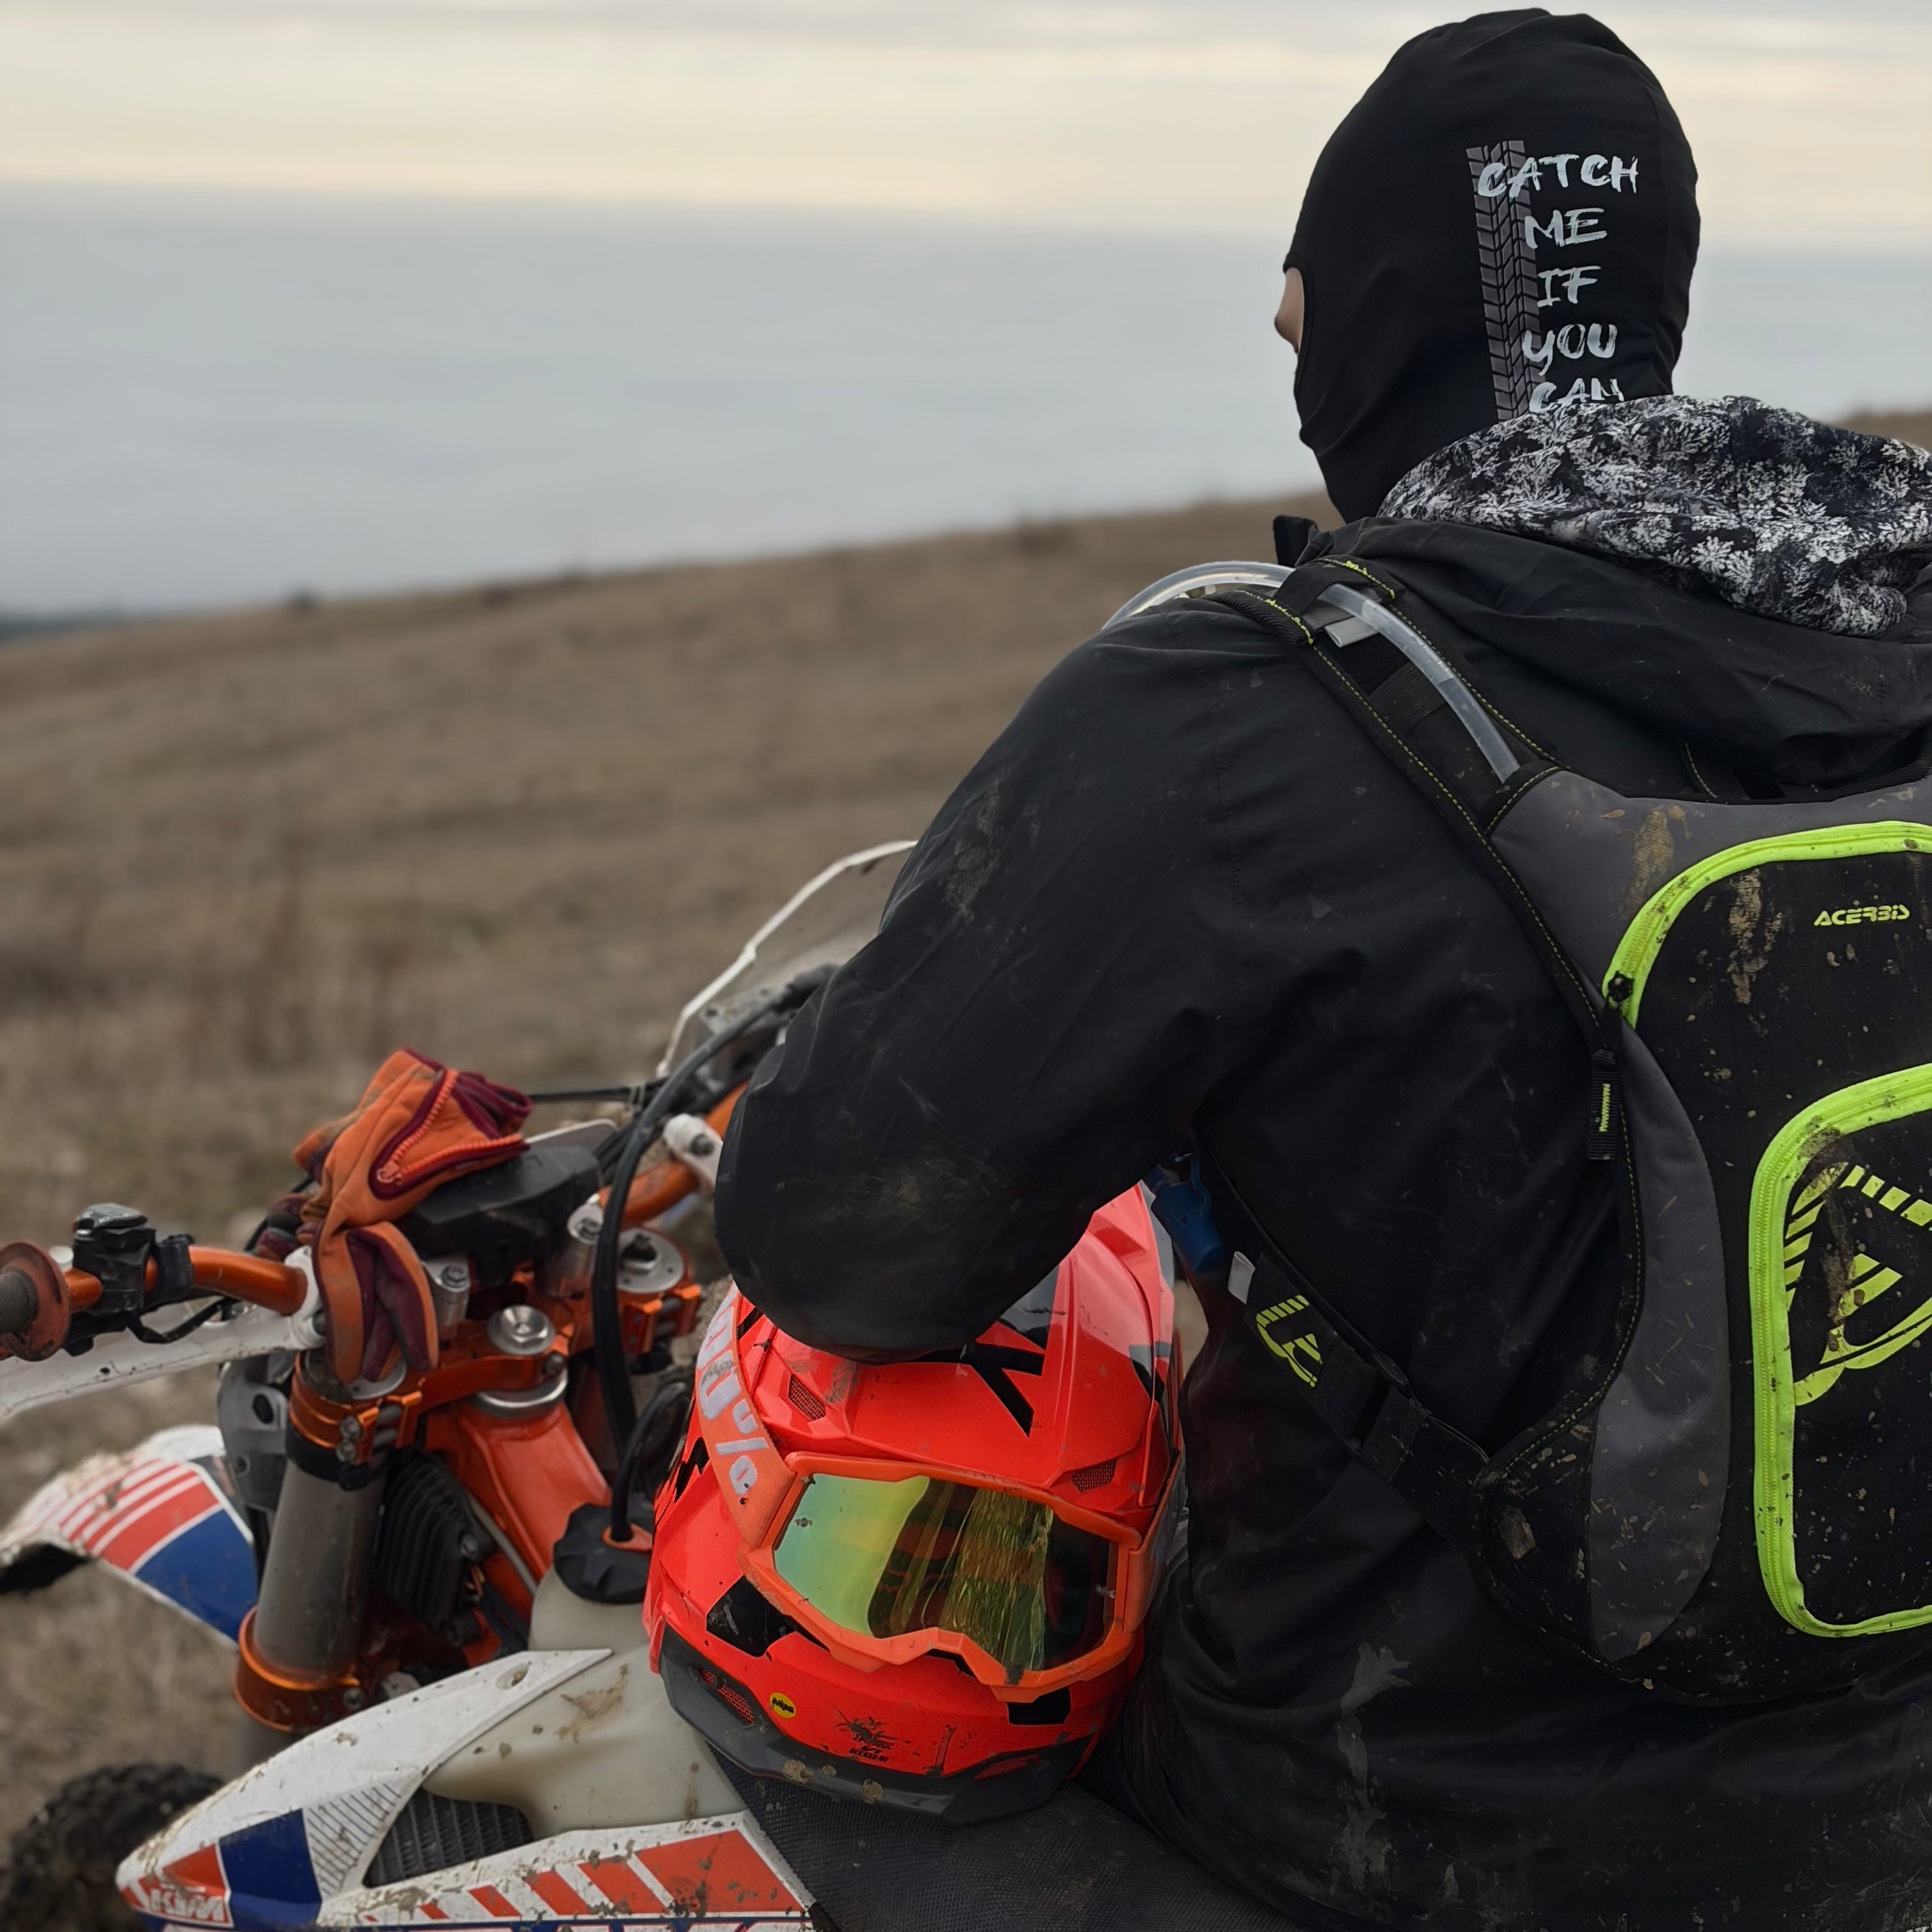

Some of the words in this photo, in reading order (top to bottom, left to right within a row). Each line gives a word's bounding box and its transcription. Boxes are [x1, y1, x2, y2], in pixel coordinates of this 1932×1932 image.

[1478, 153, 1639, 199] CATCH
[1524, 208, 1607, 249] ME
[1537, 265, 1602, 308] IF
[1522, 323, 1618, 376] YOU
[1529, 378, 1624, 413] CAN
[1814, 904, 1910, 926] ACERBIS
[149, 1883, 225, 1922] KTM
